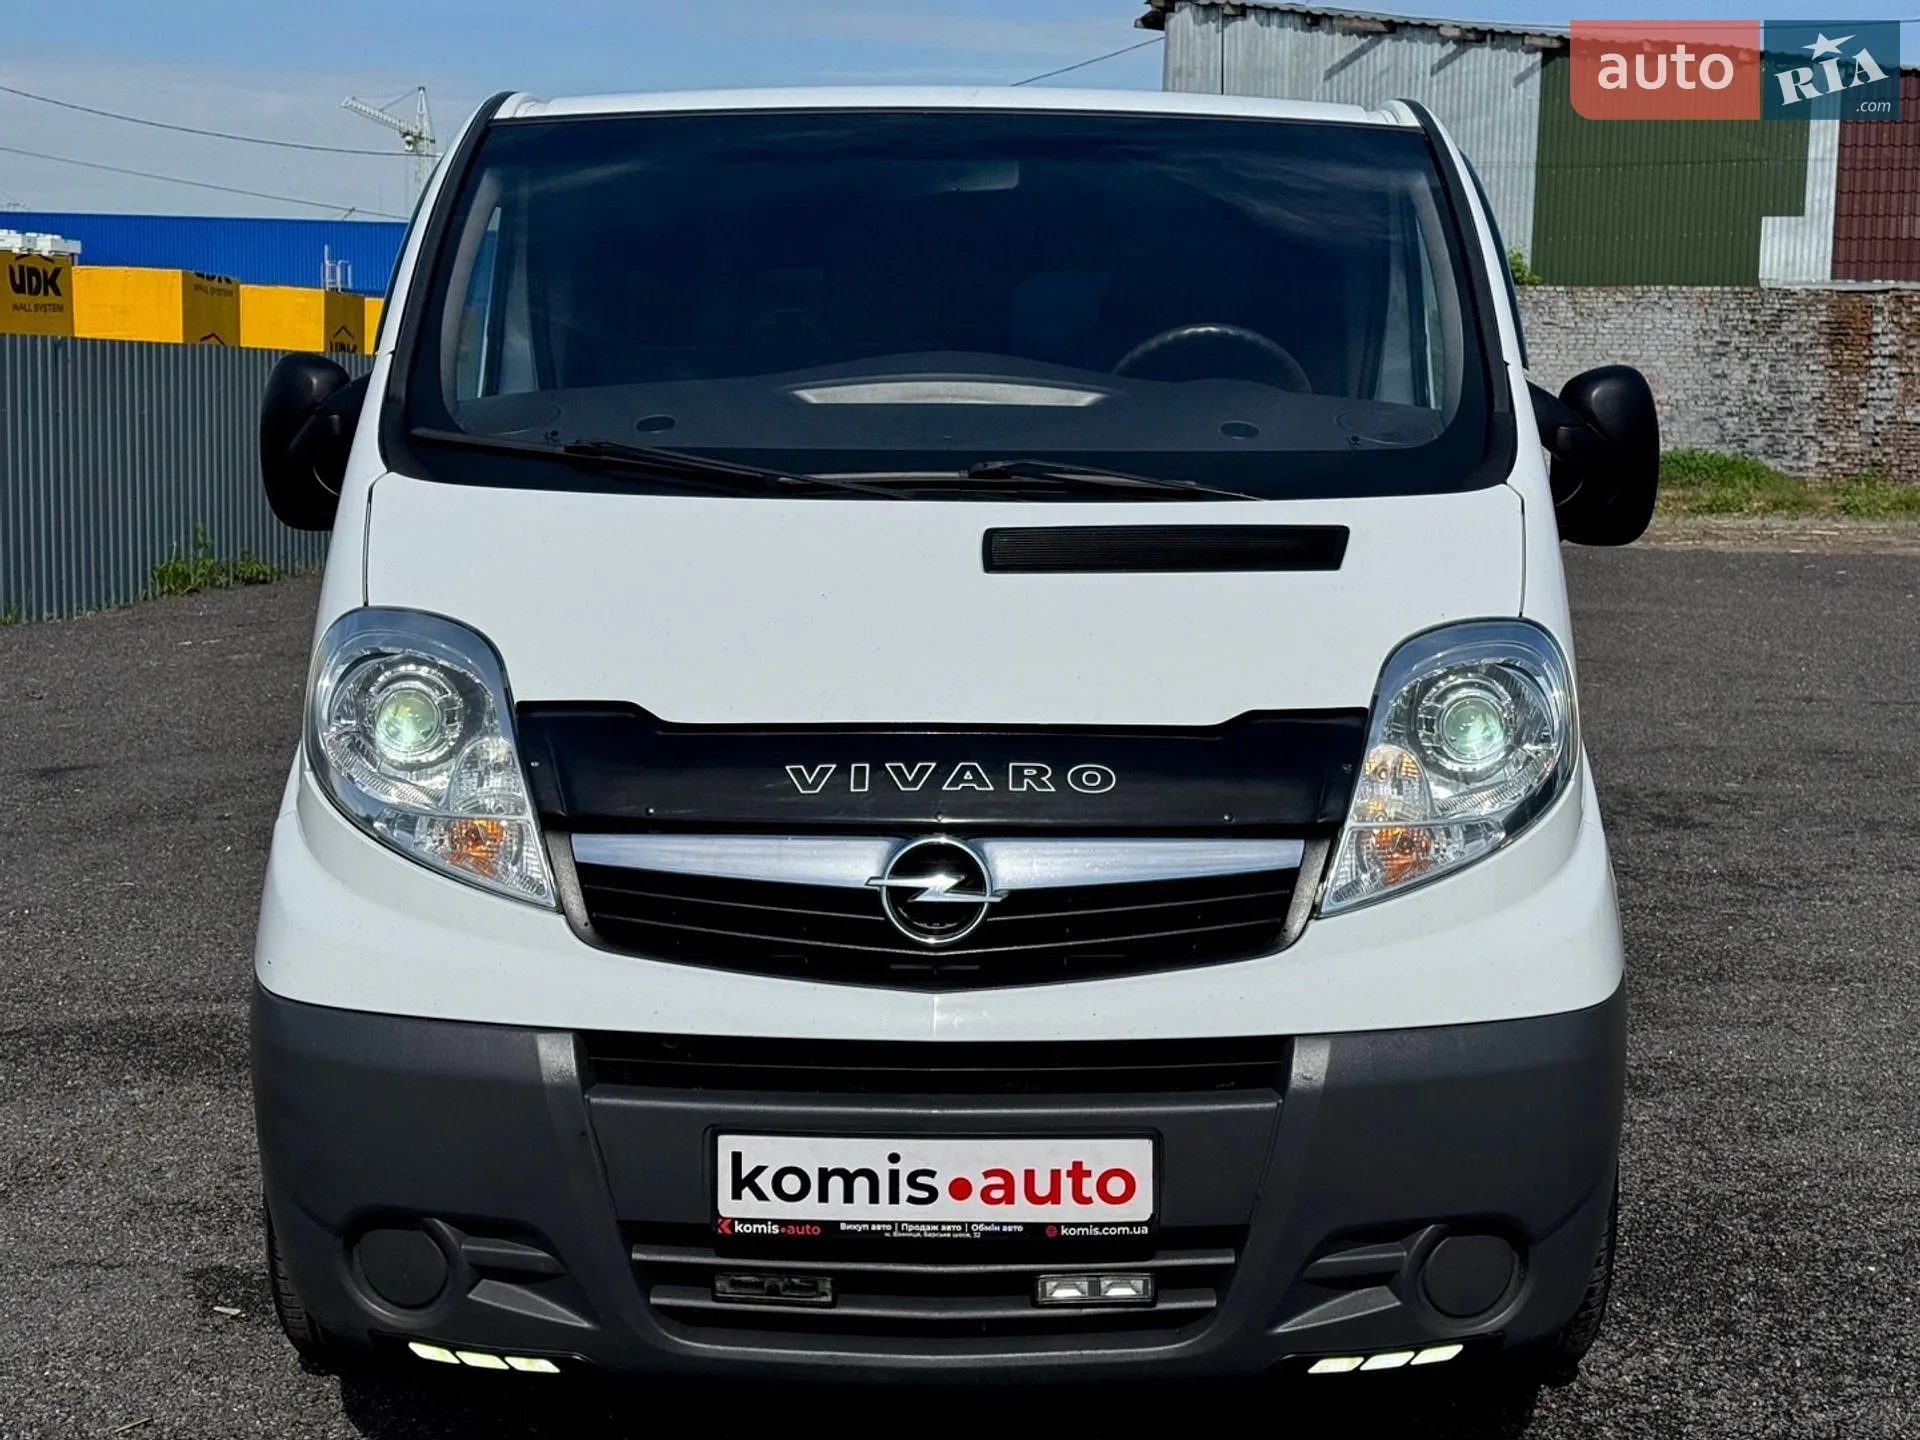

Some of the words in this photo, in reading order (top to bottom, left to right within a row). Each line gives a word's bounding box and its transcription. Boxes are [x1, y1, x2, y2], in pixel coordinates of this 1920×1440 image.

[8, 264, 63, 297] UDK
[11, 303, 32, 313] WALL
[34, 304, 64, 313] SYSTEM
[785, 762, 1116, 794] VIVARO
[840, 1222, 869, 1232] Викуп
[901, 1223, 939, 1232] Продаж
[941, 1224, 962, 1232] авто
[1061, 1224, 1148, 1236] komis.com.ua
